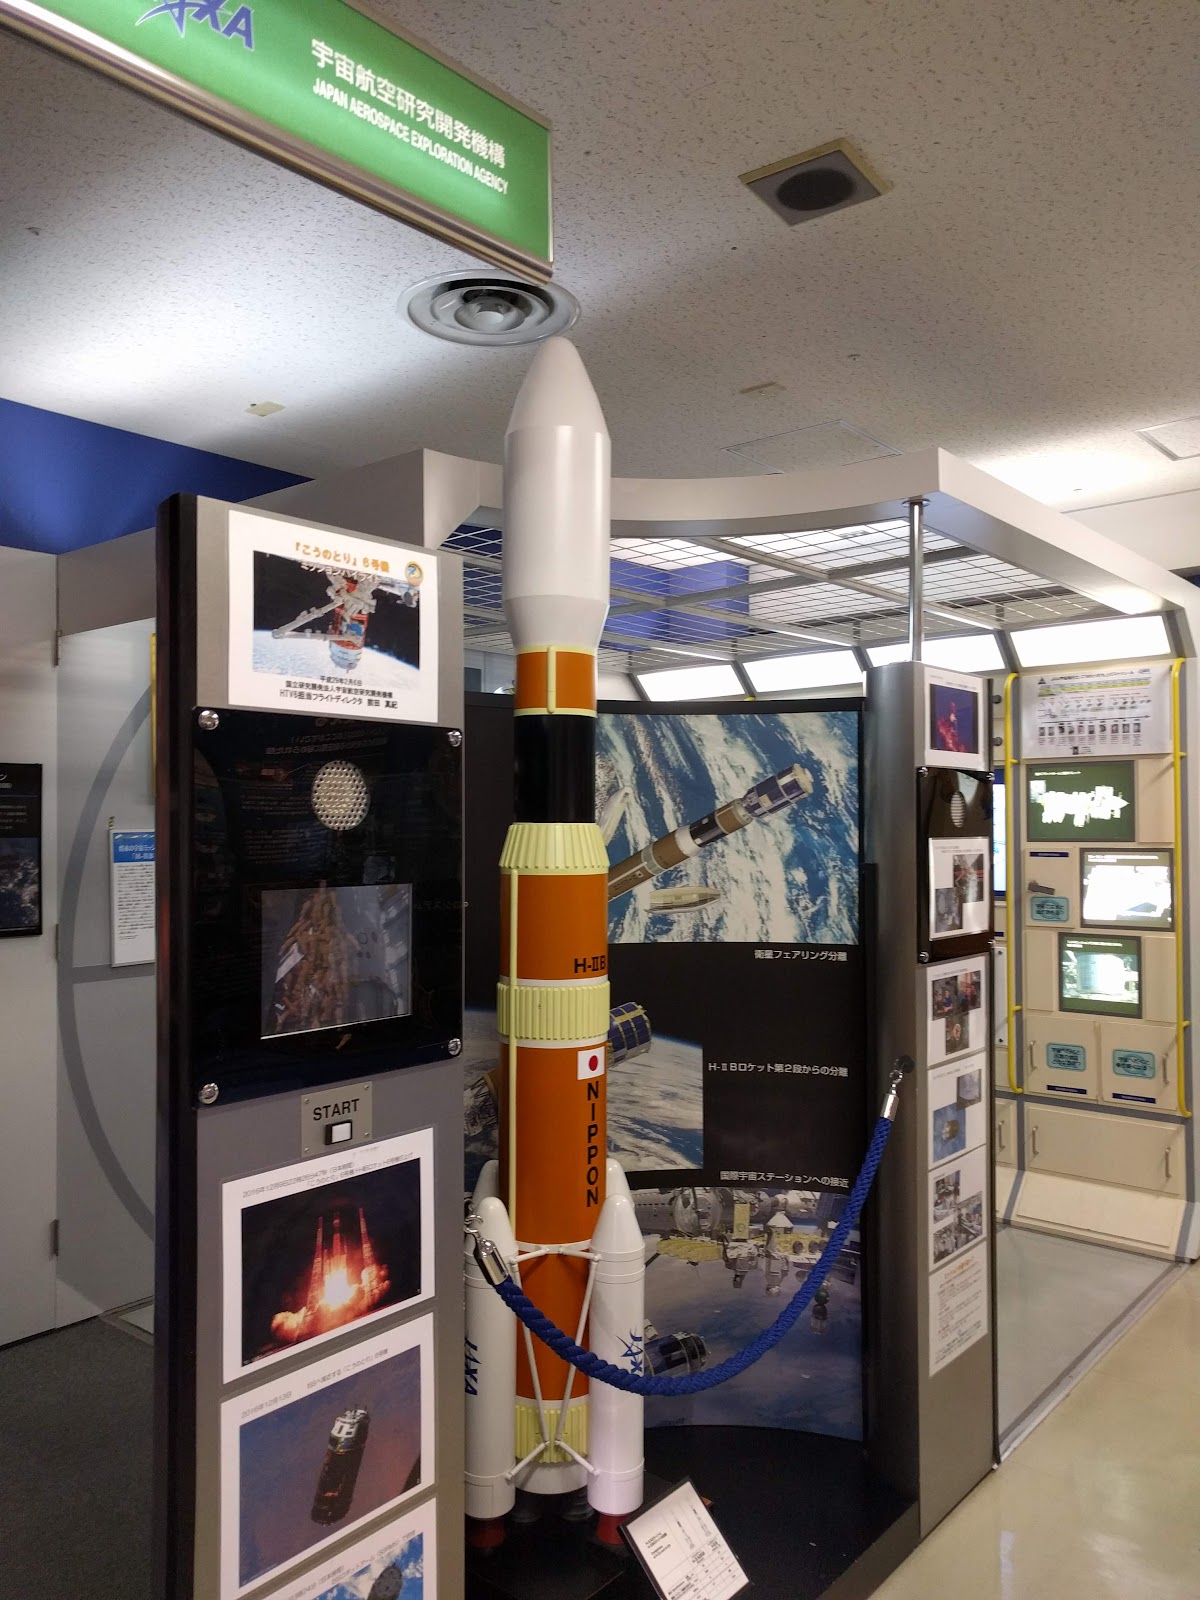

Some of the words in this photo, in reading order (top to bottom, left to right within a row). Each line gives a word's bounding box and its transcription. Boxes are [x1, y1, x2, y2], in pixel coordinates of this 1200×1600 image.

[311, 38, 506, 169] 宇宙航空研究開発機構
[313, 78, 348, 110] JAPAN
[349, 97, 410, 143] AEROSPACE
[410, 129, 473, 176] EXPLORATION
[473, 165, 509, 195] AGENCY
[300, 561, 381, 583] ミッションハイライト
[754, 949, 848, 962] 衛星フェアリング分離
[312, 1098, 361, 1121] START
[586, 1080, 599, 1208] NIPPON
[719, 1170, 849, 1189] 国際宇宙ステーションへの接近
[615, 1328, 644, 1375] JAX
